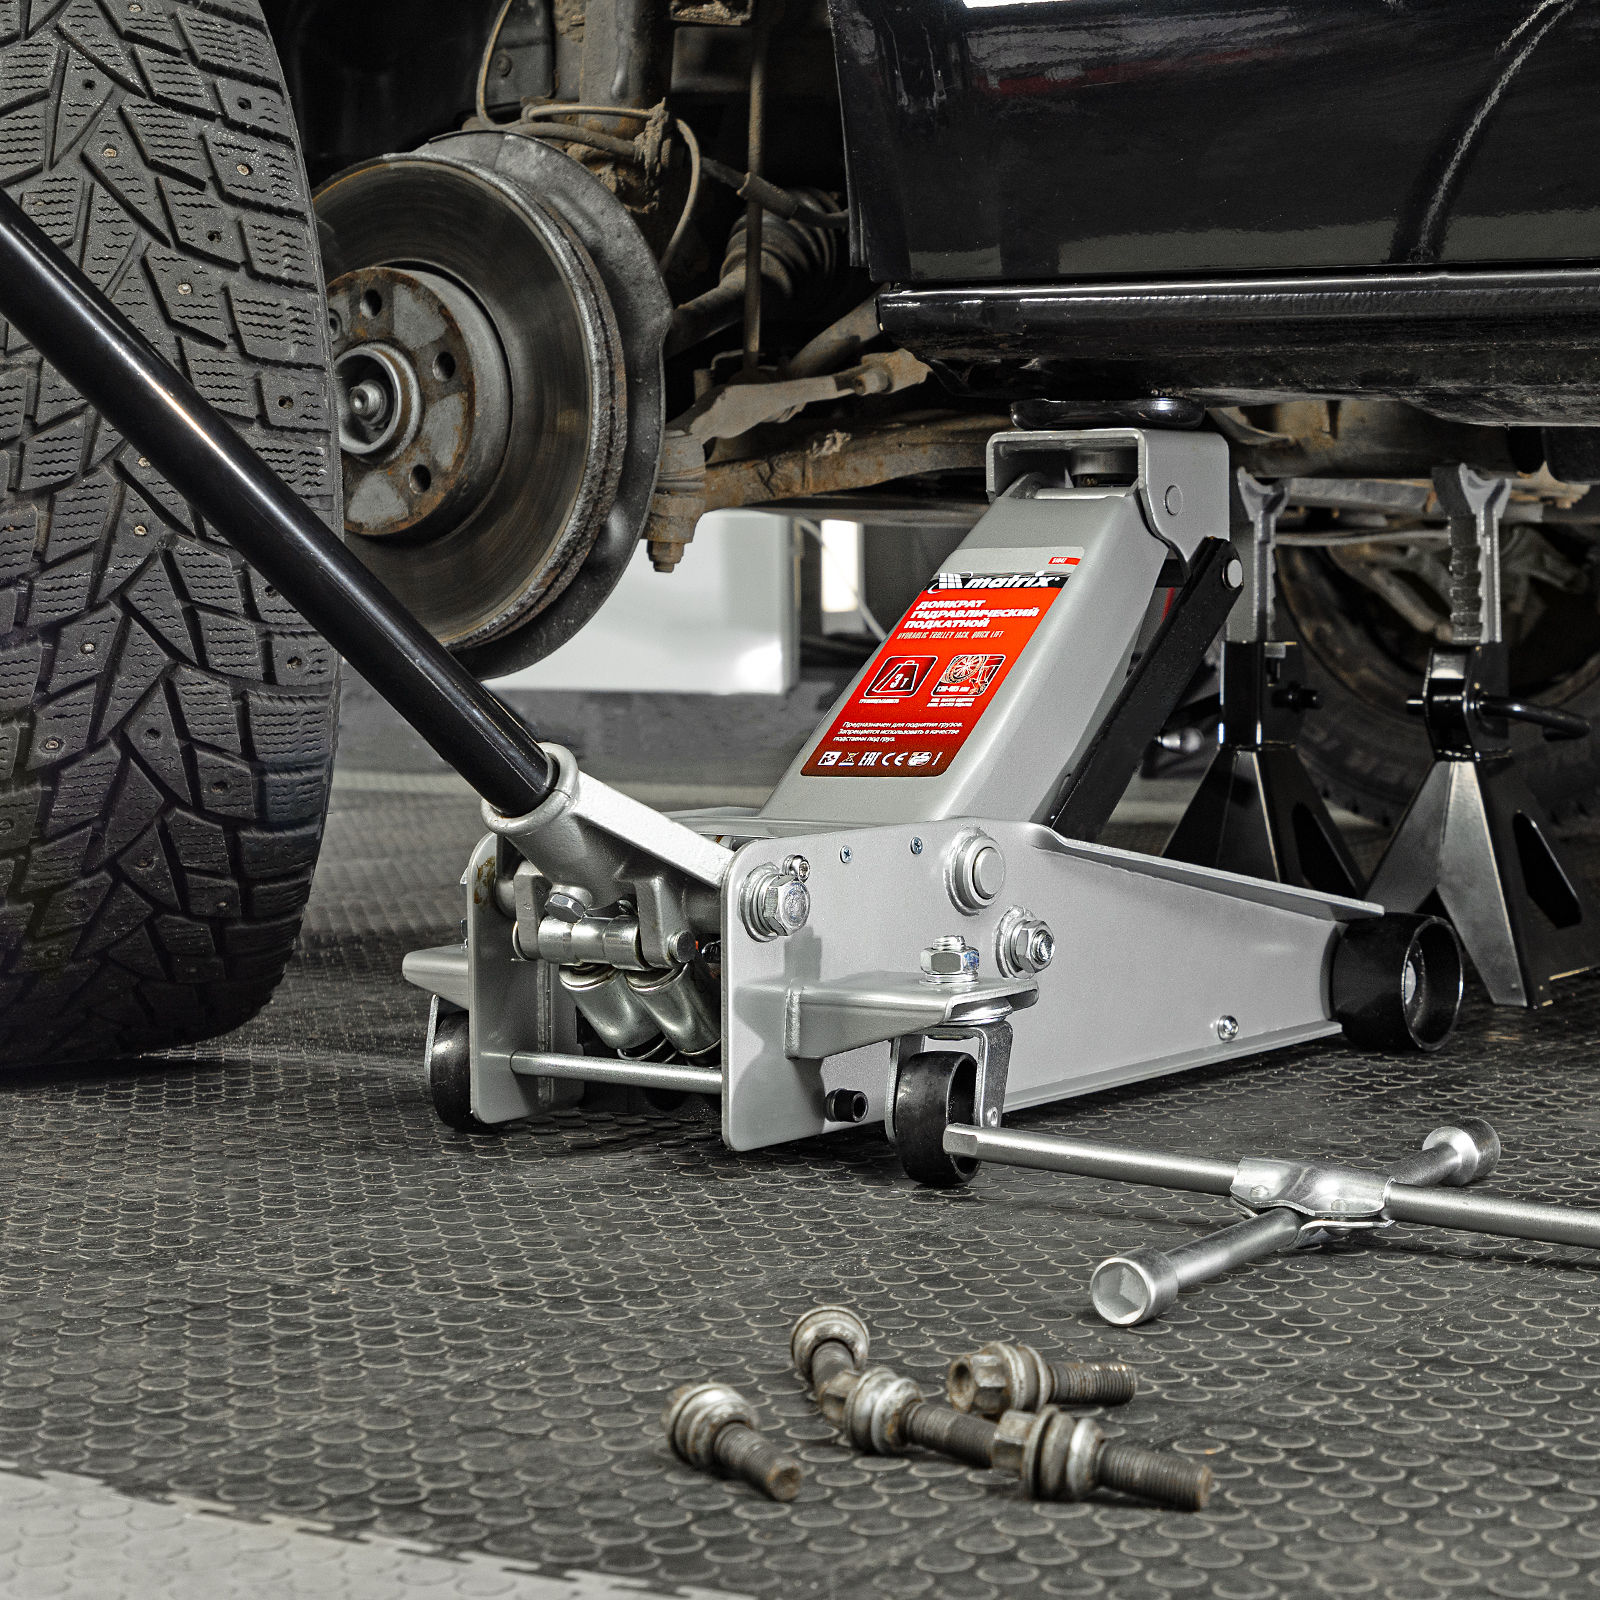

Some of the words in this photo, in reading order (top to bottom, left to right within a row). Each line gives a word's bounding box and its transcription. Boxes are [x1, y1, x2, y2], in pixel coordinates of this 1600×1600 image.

[963, 570, 1056, 589] matrix
[915, 599, 987, 611] ДОМКРАТ
[910, 606, 1040, 620] ГИДРАВЛИЧЕСКИЙ
[903, 617, 991, 630] ПОДКАТНОЙ
[929, 631, 955, 640] TROLLEY
[990, 630, 1005, 638] LIFT
